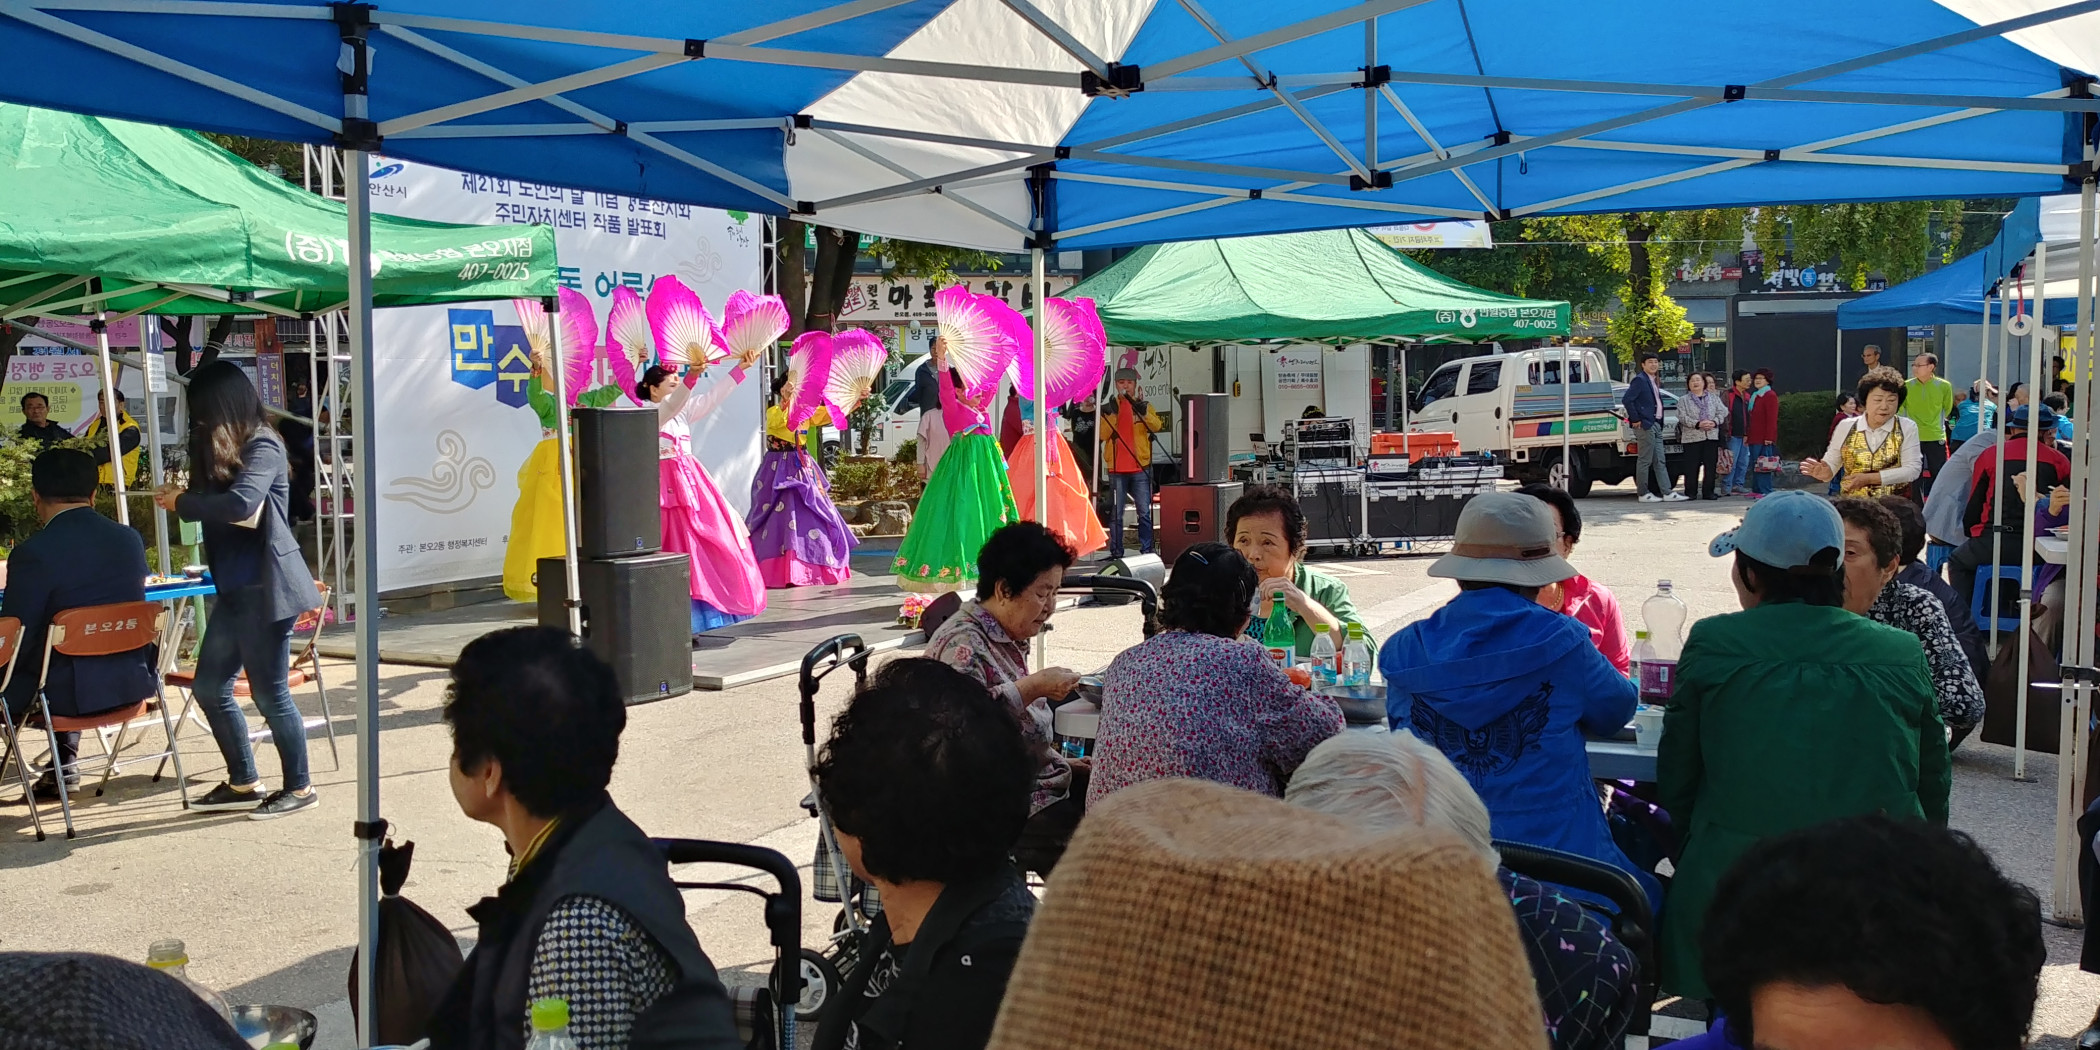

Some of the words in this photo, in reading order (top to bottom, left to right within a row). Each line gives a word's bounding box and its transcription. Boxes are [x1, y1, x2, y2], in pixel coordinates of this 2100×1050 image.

[369, 183, 408, 199] 안산시
[461, 173, 511, 197] 제21회
[495, 202, 587, 230] 주민자치센터
[593, 213, 622, 234] 작품
[627, 217, 667, 240] 발표회
[286, 231, 334, 265] (증)
[457, 262, 531, 281] 407-0025
[867, 284, 880, 311] 원조
[1436, 310, 1457, 324] (증)
[1520, 308, 1557, 319] 본오지점
[1513, 319, 1558, 329] 407-0025
[270, 361, 281, 405] 더치커피
[419, 541, 446, 553] 본오2동
[447, 537, 488, 550] 행정복지센터
[84, 618, 138, 636] 본오2동
